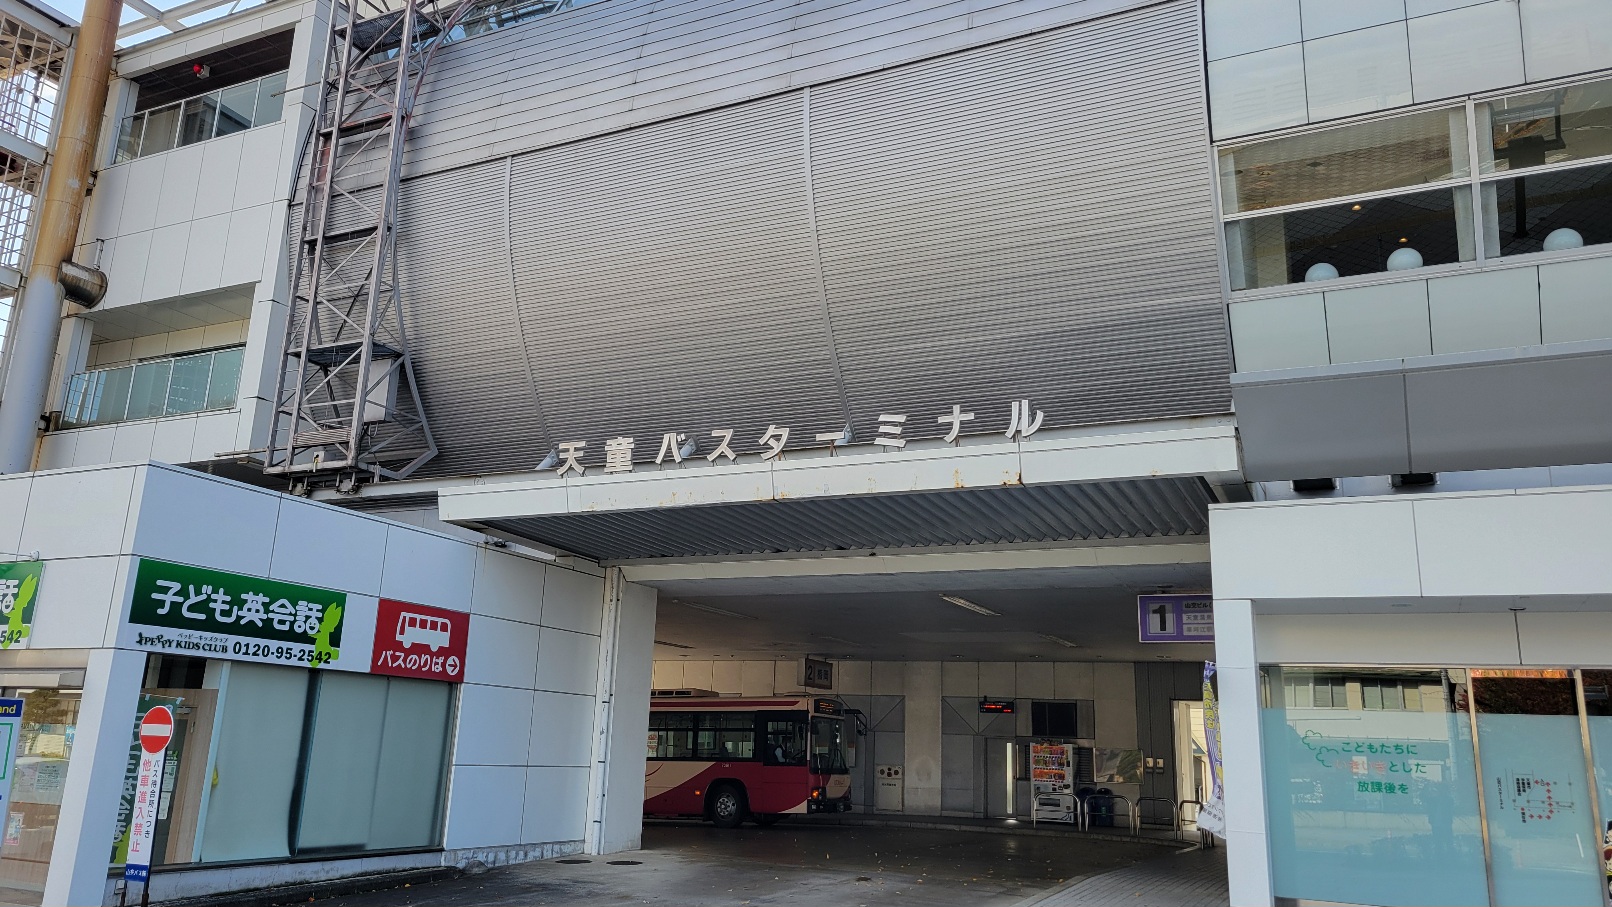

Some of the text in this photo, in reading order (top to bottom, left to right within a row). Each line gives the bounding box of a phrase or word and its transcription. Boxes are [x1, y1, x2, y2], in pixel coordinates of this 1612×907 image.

[557, 399, 1044, 476] 天童バスターミナル
[150, 579, 323, 636] 子ども英会話
[1152, 604, 1167, 632] 1
[143, 634, 332, 665] PEPPY KIDS CLUB 0120-95-2542
[377, 650, 444, 673] バスのりば
[1341, 742, 1419, 755] こどもたちに
[144, 759, 160, 839] バス待合所につき
[1356, 781, 1409, 795] 放課後を
[131, 758, 152, 853] 他車進入禁止
